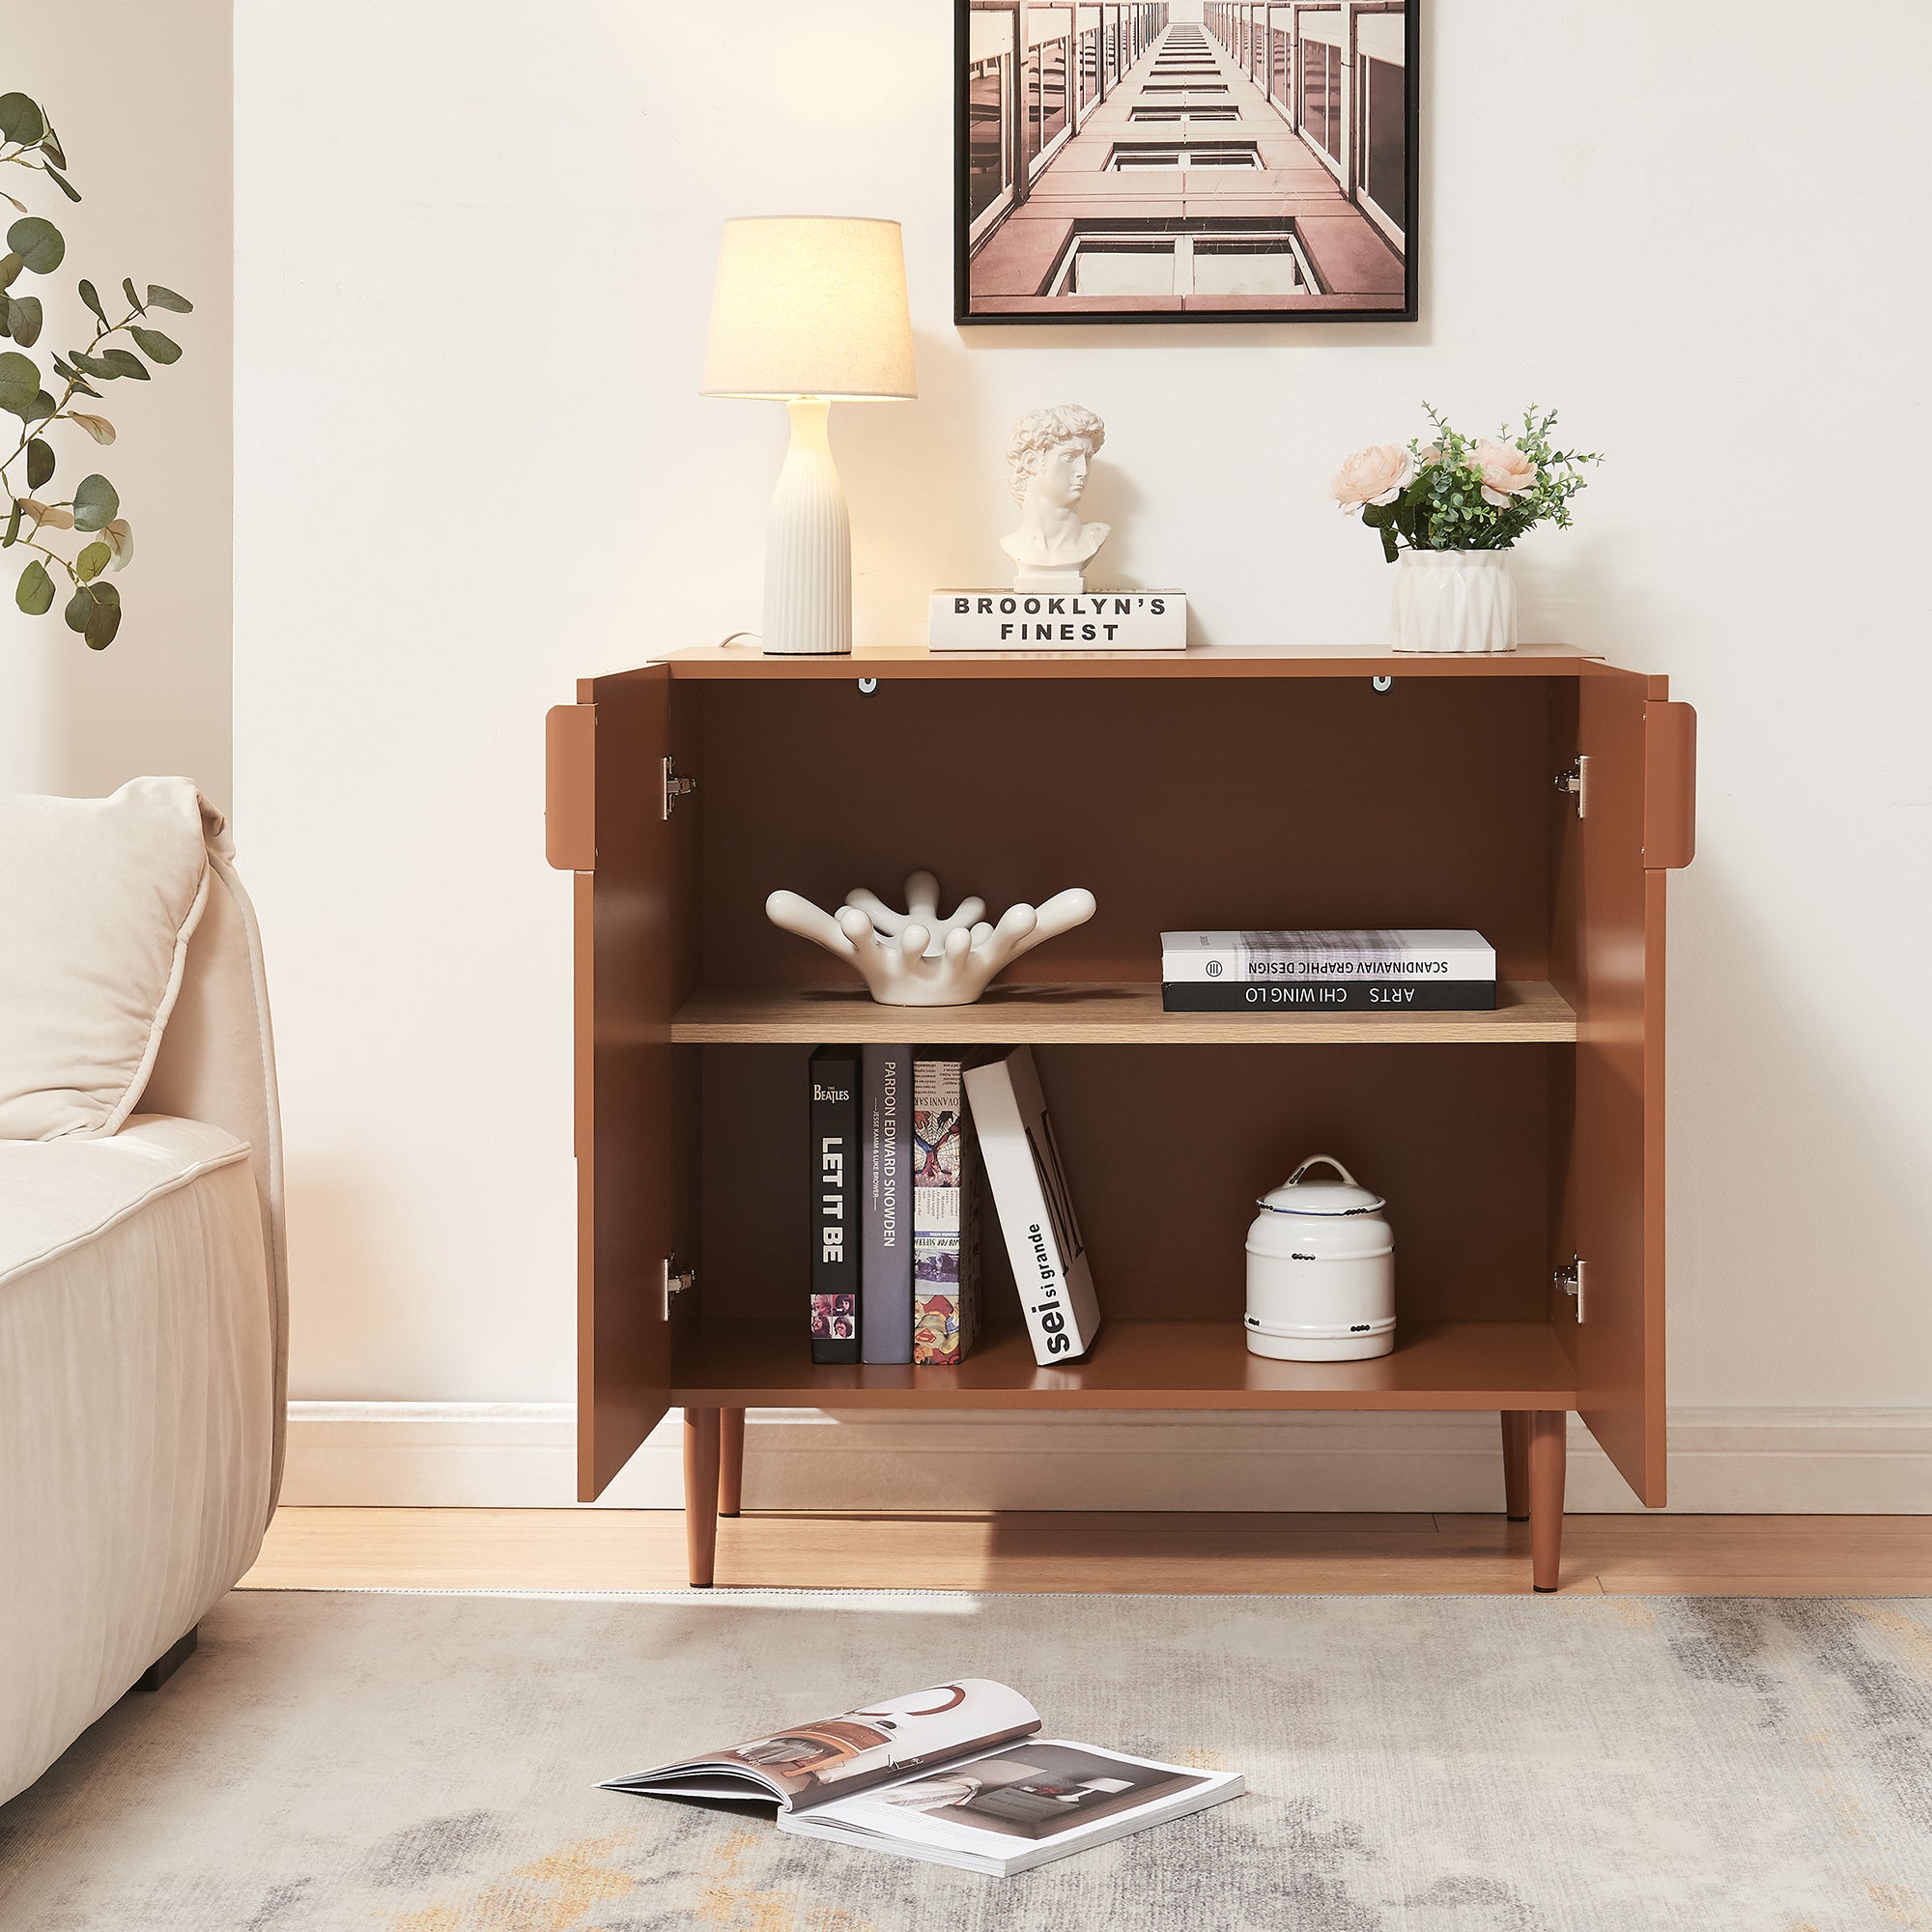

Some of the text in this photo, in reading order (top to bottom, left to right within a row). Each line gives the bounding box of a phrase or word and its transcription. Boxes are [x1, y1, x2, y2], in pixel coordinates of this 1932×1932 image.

[954, 597, 1166, 614] BROOKLYN'S
[1001, 623, 1119, 640] FINEST
[1248, 961, 1448, 974] SCANDINAVIAV GRAPHIC DESIGN
[1245, 987, 1415, 1003] ARTS CHI WING LO
[883, 1062, 896, 1247] PARDON EDWARD SNOWDEN
[822, 1137, 843, 1263] LET IT BE
[1028, 1223, 1070, 1354] sei si grande
